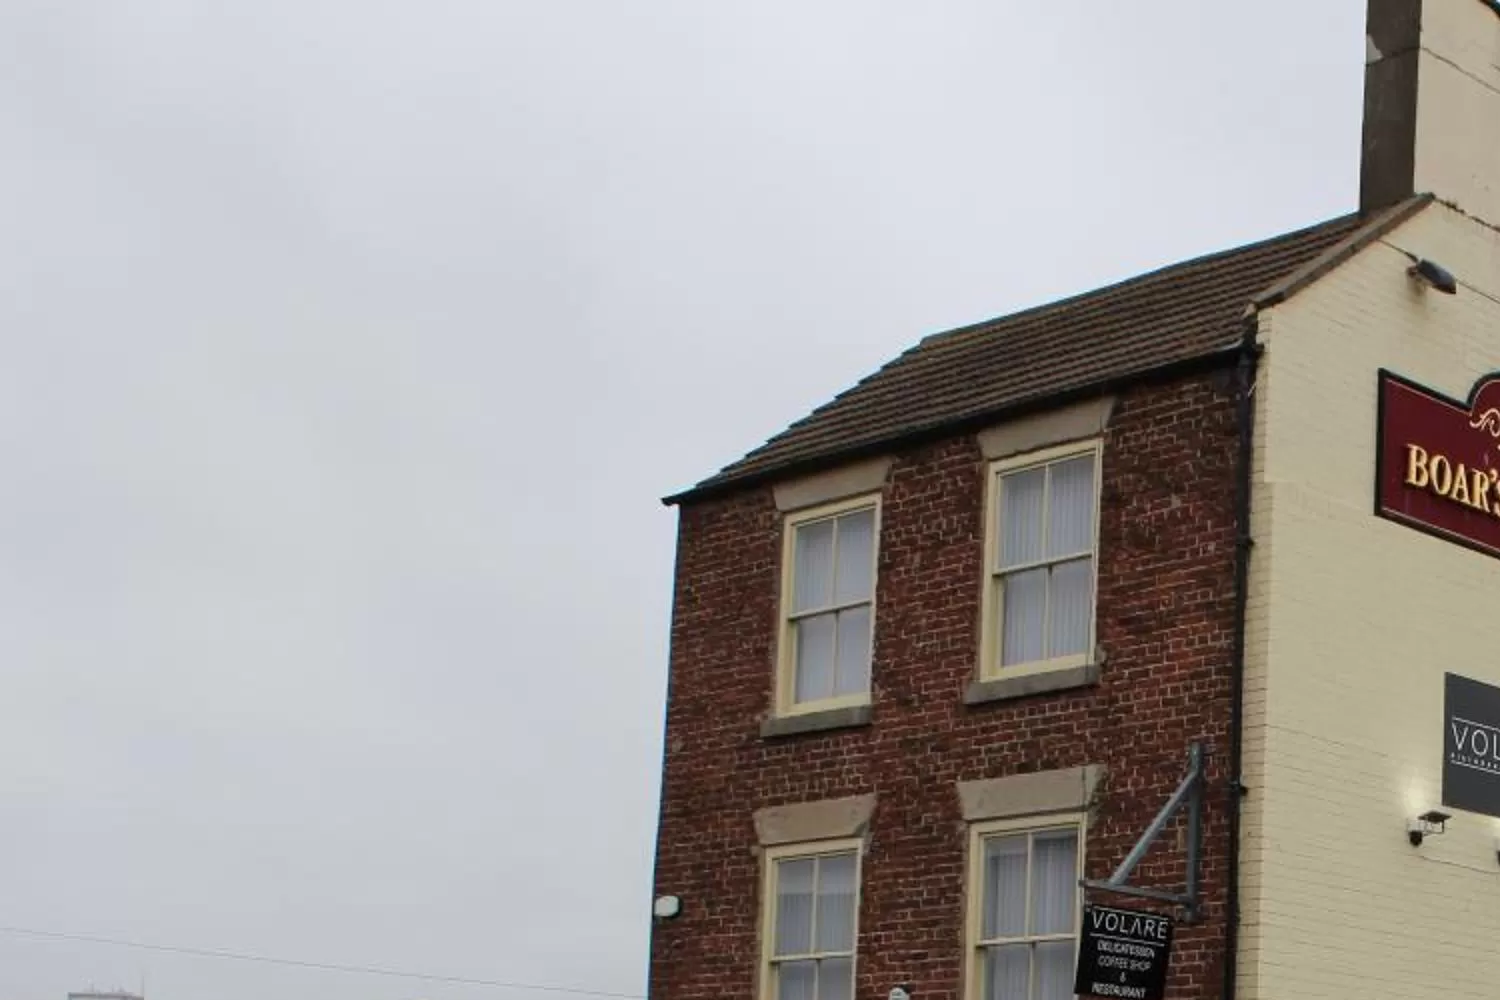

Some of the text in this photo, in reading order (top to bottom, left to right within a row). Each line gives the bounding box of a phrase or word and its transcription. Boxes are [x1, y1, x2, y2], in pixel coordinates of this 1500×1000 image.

[1092, 911, 1168, 939] VOLARE
[1098, 956, 1128, 969] COFFEE
[1091, 981, 1146, 999] RESTAURANT
